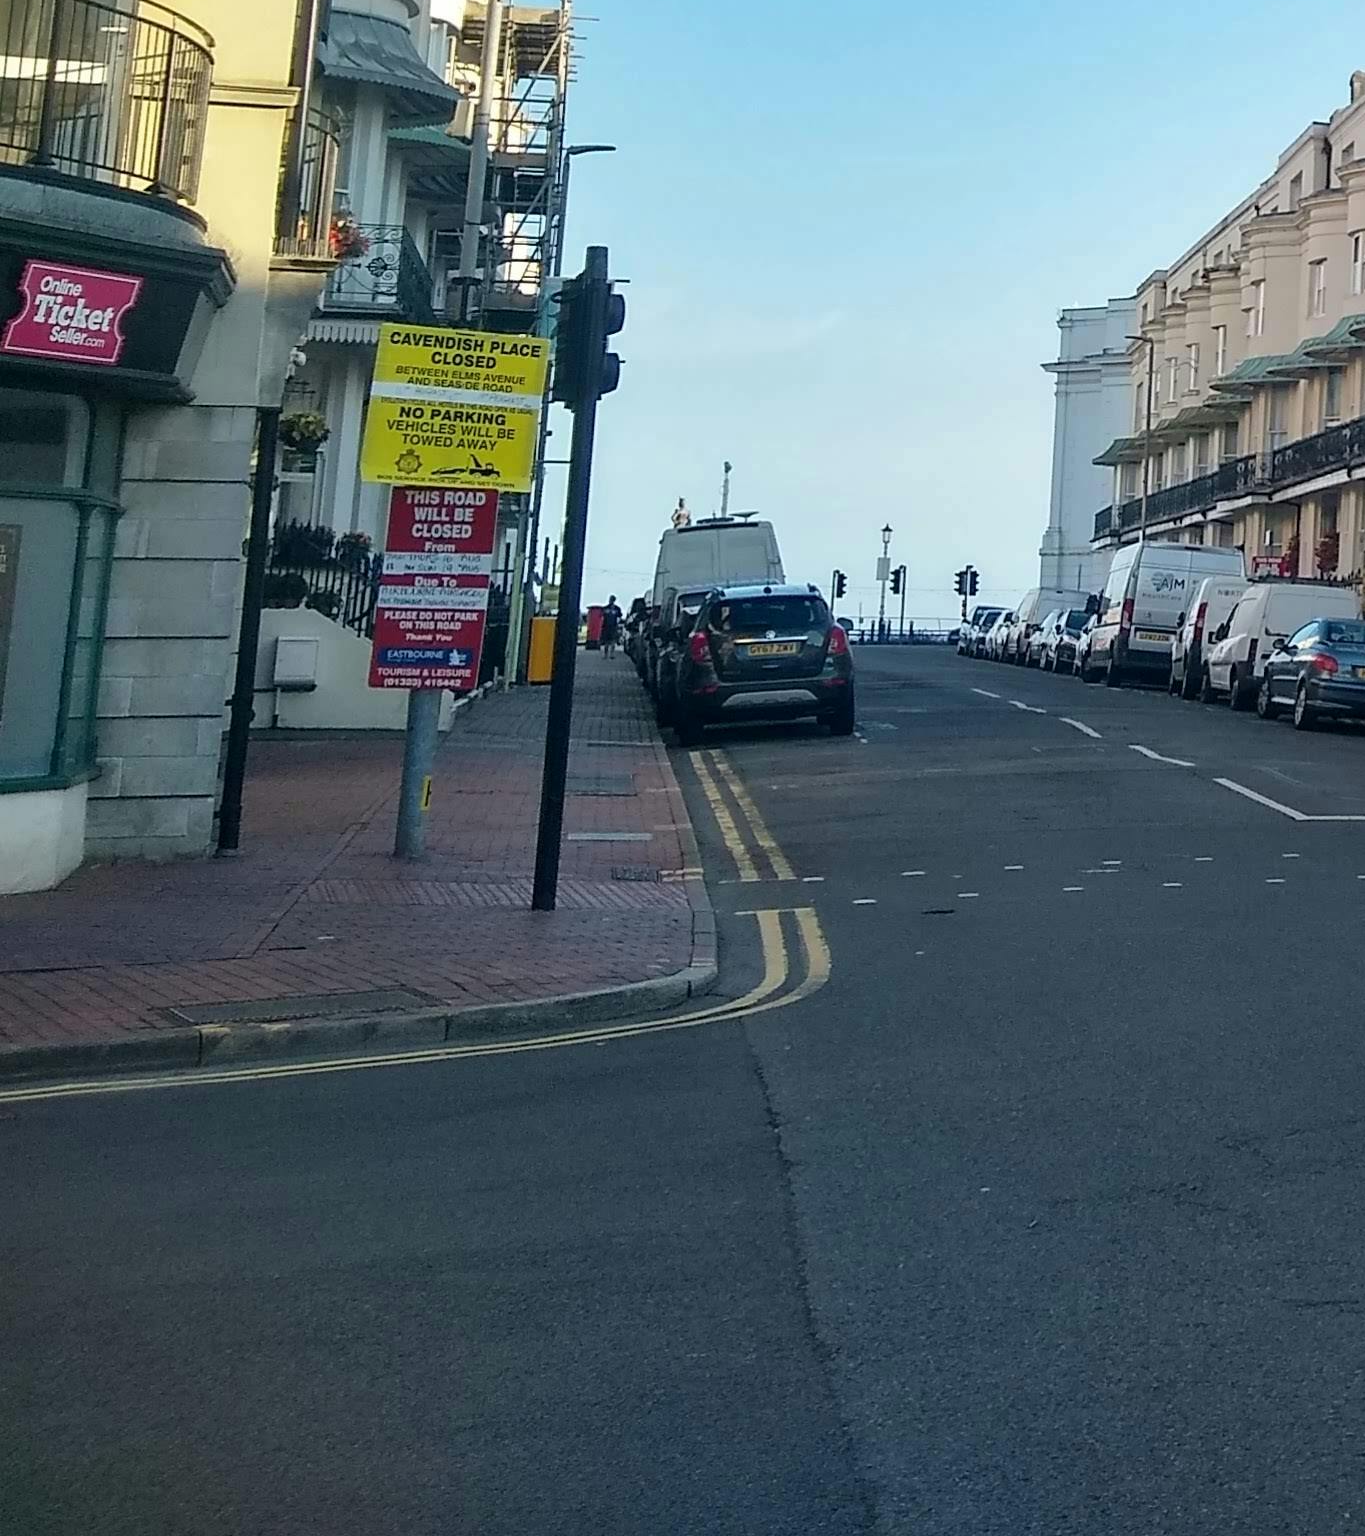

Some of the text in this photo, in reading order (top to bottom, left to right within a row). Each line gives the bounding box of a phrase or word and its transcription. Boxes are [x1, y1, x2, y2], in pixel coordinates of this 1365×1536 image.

[40, 276, 82, 296] Online
[32, 293, 115, 332] Ticket
[389, 331, 542, 358] CAVENDISH PLACE
[431, 351, 497, 369] CLOSED
[395, 365, 526, 385] BETWEEN ELMS AVENUE
[407, 376, 431, 386] AND
[482, 382, 513, 393] ROAD
[399, 406, 506, 426] NO PARKING
[387, 419, 516, 440] VEHICLES WILL BE
[402, 433, 497, 451] TOWED AWAY
[405, 490, 486, 506] THIS ROAD
[414, 507, 475, 522] WILL BE
[411, 524, 472, 539] CLOSED
[424, 541, 456, 552] From
[414, 576, 457, 587] Due To
[1161, 578, 1186, 593] AJM
[384, 611, 479, 621] PLEASE DO NOT PARK
[399, 621, 462, 630] ON THIS ROAD
[406, 633, 454, 642] Thank You
[387, 650, 445, 659] EASTBOURNE
[377, 667, 472, 678] TOURISM & LEISURE
